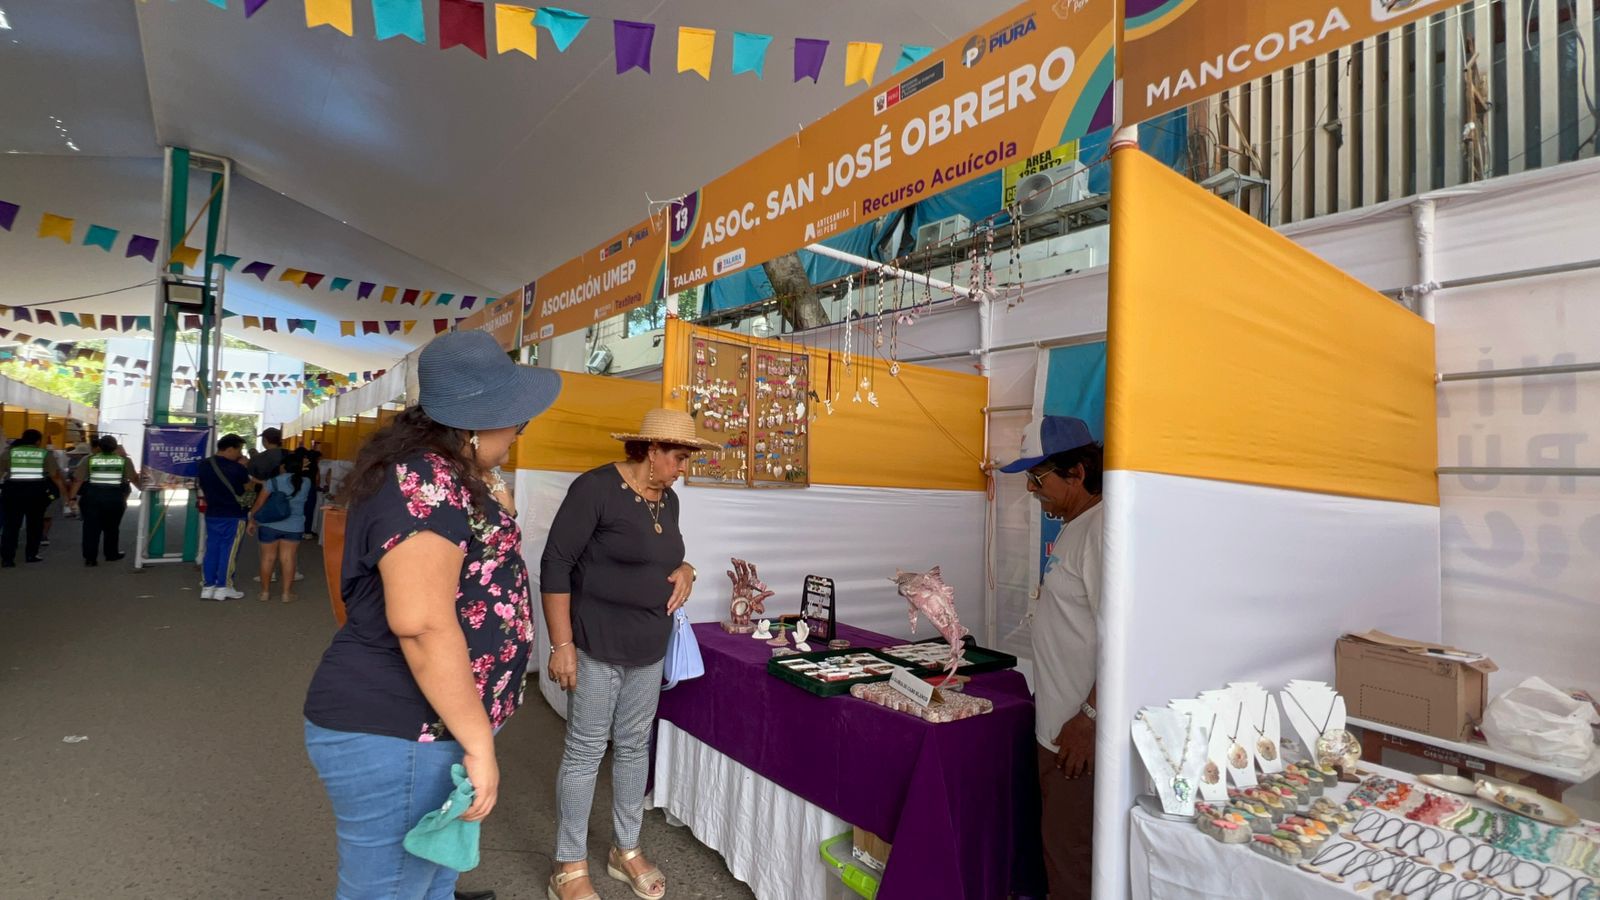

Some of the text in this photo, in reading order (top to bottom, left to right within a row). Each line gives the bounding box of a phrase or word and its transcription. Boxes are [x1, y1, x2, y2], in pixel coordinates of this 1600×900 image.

[989, 16, 1037, 53] PIURA
[1146, 6, 1351, 108] MANCORA
[701, 202, 760, 249] ASOC.
[766, 172, 814, 219] SAN
[821, 124, 892, 196] JOSÉ
[901, 46, 1076, 156] OBRERO
[1026, 150, 1052, 169] AREA
[862, 141, 1017, 216] Recurso Acuícola
[675, 207, 688, 232] 13
[541, 259, 637, 318] ASOCIACIÓN UMEP
[673, 266, 708, 288] TALARA
